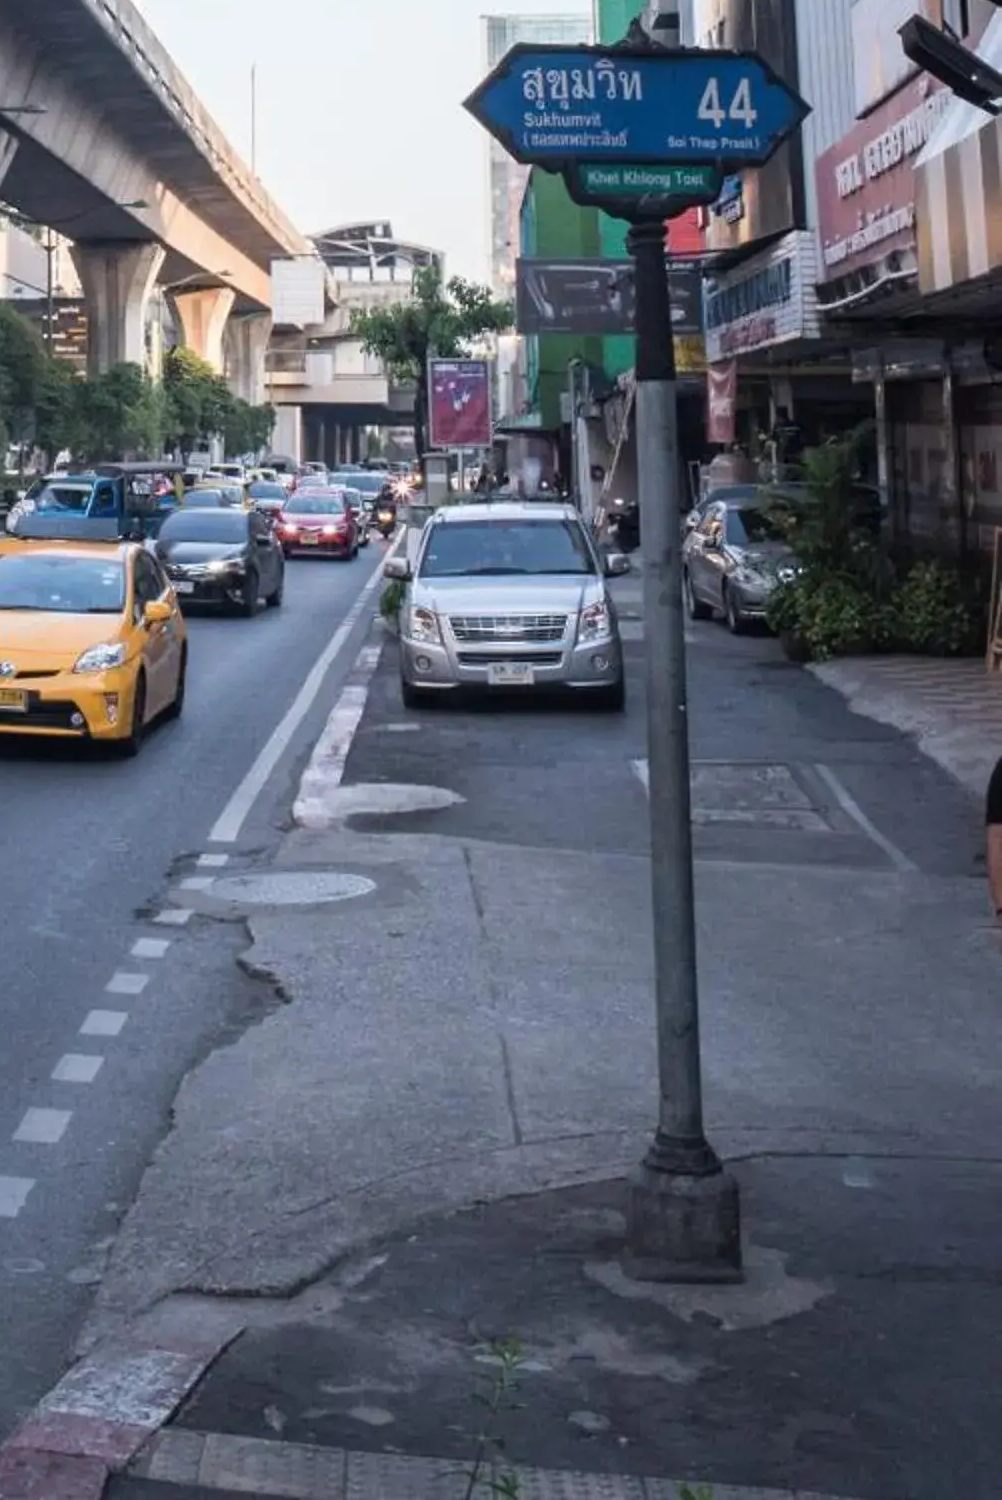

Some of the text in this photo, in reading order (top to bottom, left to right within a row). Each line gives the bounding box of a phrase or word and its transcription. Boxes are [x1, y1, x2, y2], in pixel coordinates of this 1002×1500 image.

[522, 59, 643, 110] สุขุมวิท
[697, 77, 758, 129] 44
[523, 112, 602, 127] Sukhumvit
[667, 136, 687, 147] Soi
[587, 170, 704, 188] Khet Khlong Toei
